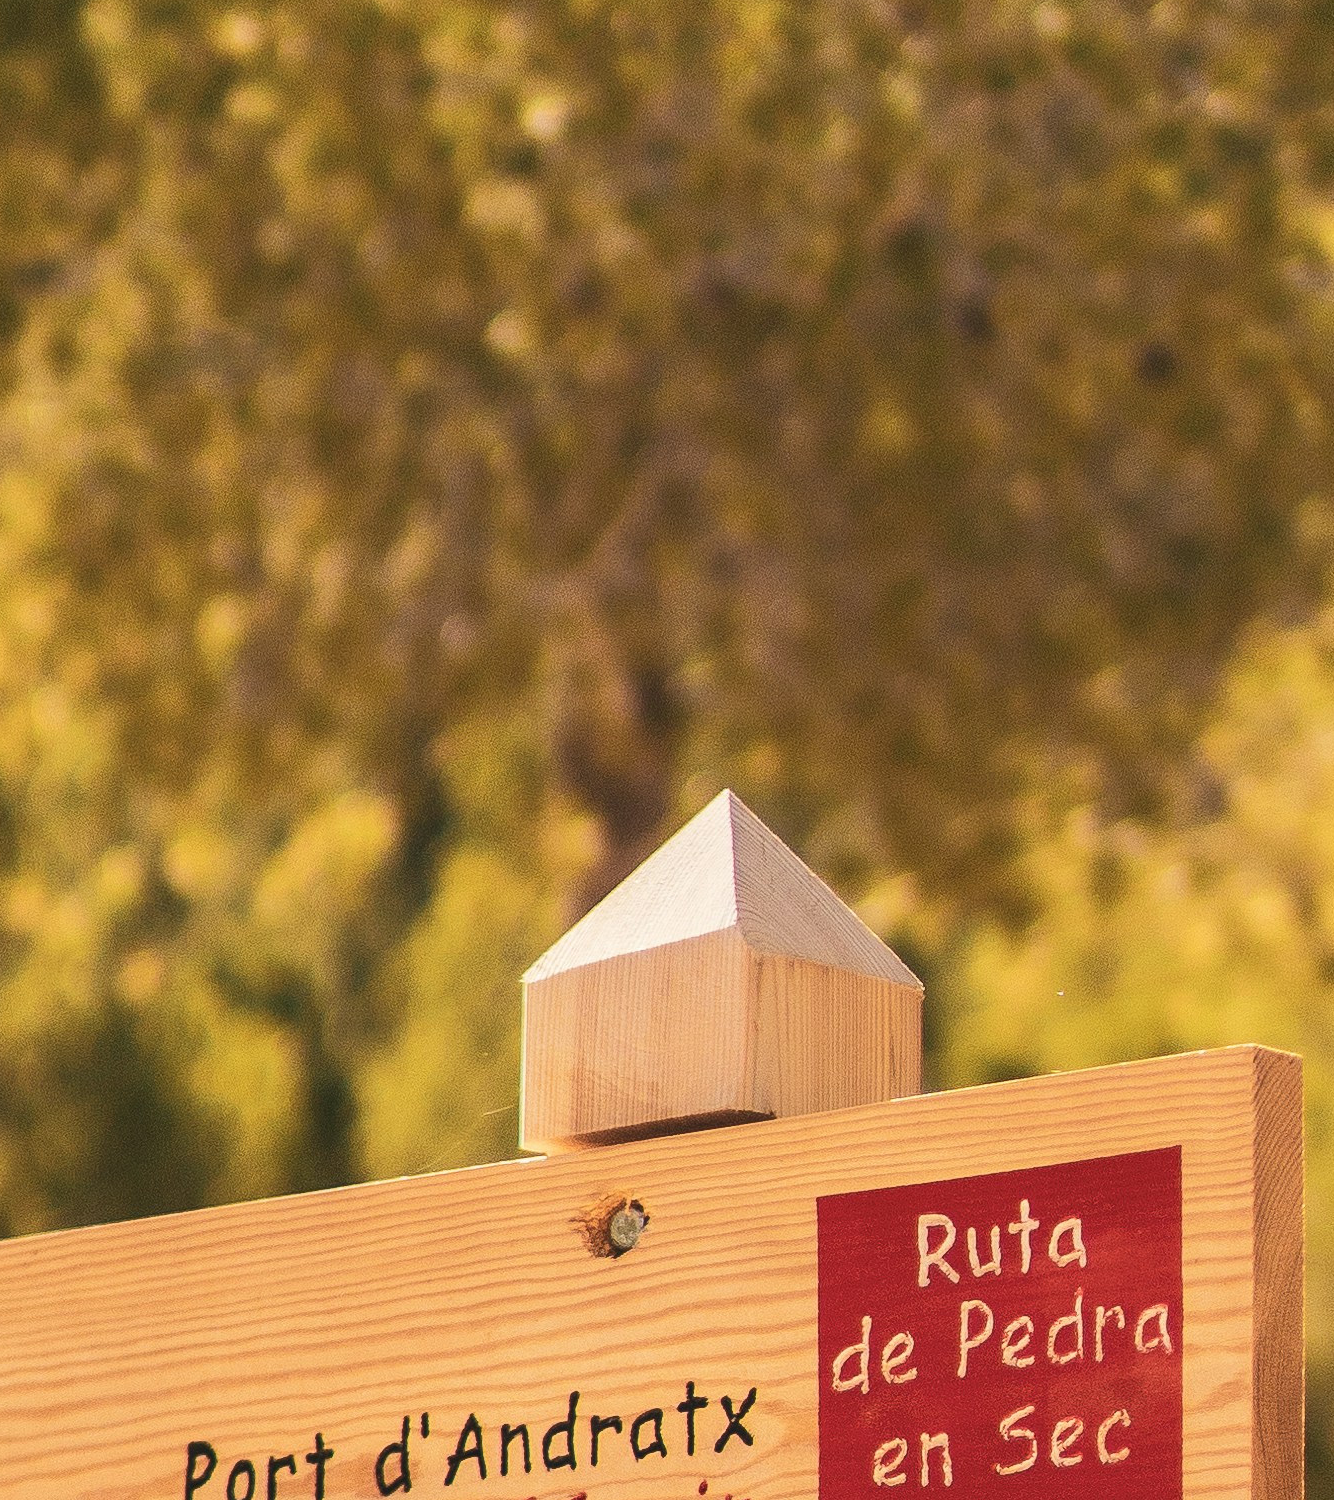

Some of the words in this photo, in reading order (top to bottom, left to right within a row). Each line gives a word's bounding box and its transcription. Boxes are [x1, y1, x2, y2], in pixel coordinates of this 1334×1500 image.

[917, 1199, 1087, 1287] Ruta
[831, 1315, 917, 1394] de
[957, 1287, 1173, 1378] Pedra
[375, 1380, 758, 1496] d'Andratx
[872, 1431, 953, 1487] en
[996, 1406, 1132, 1475] Sec
